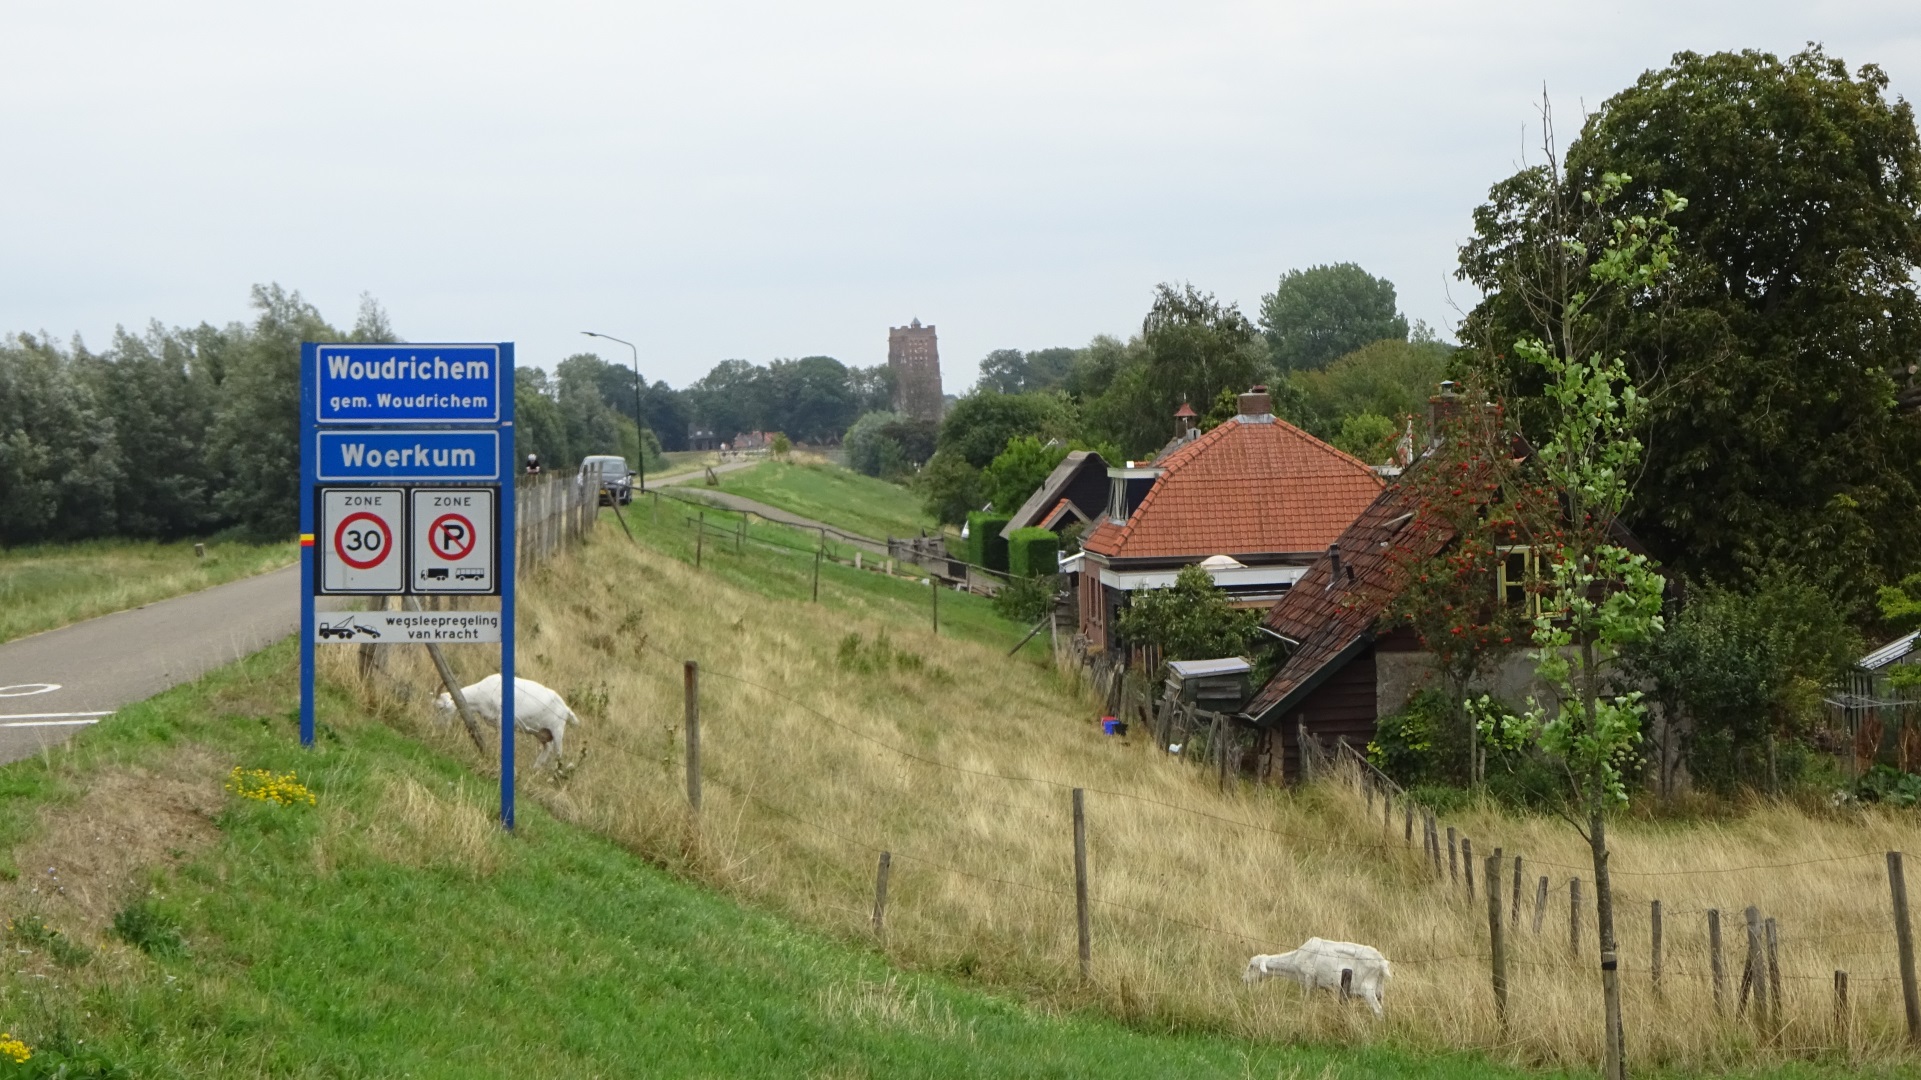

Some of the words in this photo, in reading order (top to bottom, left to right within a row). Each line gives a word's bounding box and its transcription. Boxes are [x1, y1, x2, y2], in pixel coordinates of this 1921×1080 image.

[327, 355, 489, 380] Woudrichem
[330, 396, 372, 412] gem.
[377, 393, 488, 408] Woudrichem
[341, 443, 476, 467] Woerkum
[344, 496, 382, 506] ZONE
[434, 497, 471, 507] ZONE
[346, 530, 381, 551] 30
[444, 524, 465, 550] P
[386, 615, 498, 628] wegsleepregeling
[408, 630, 431, 639] van
[435, 629, 479, 639] kracht
